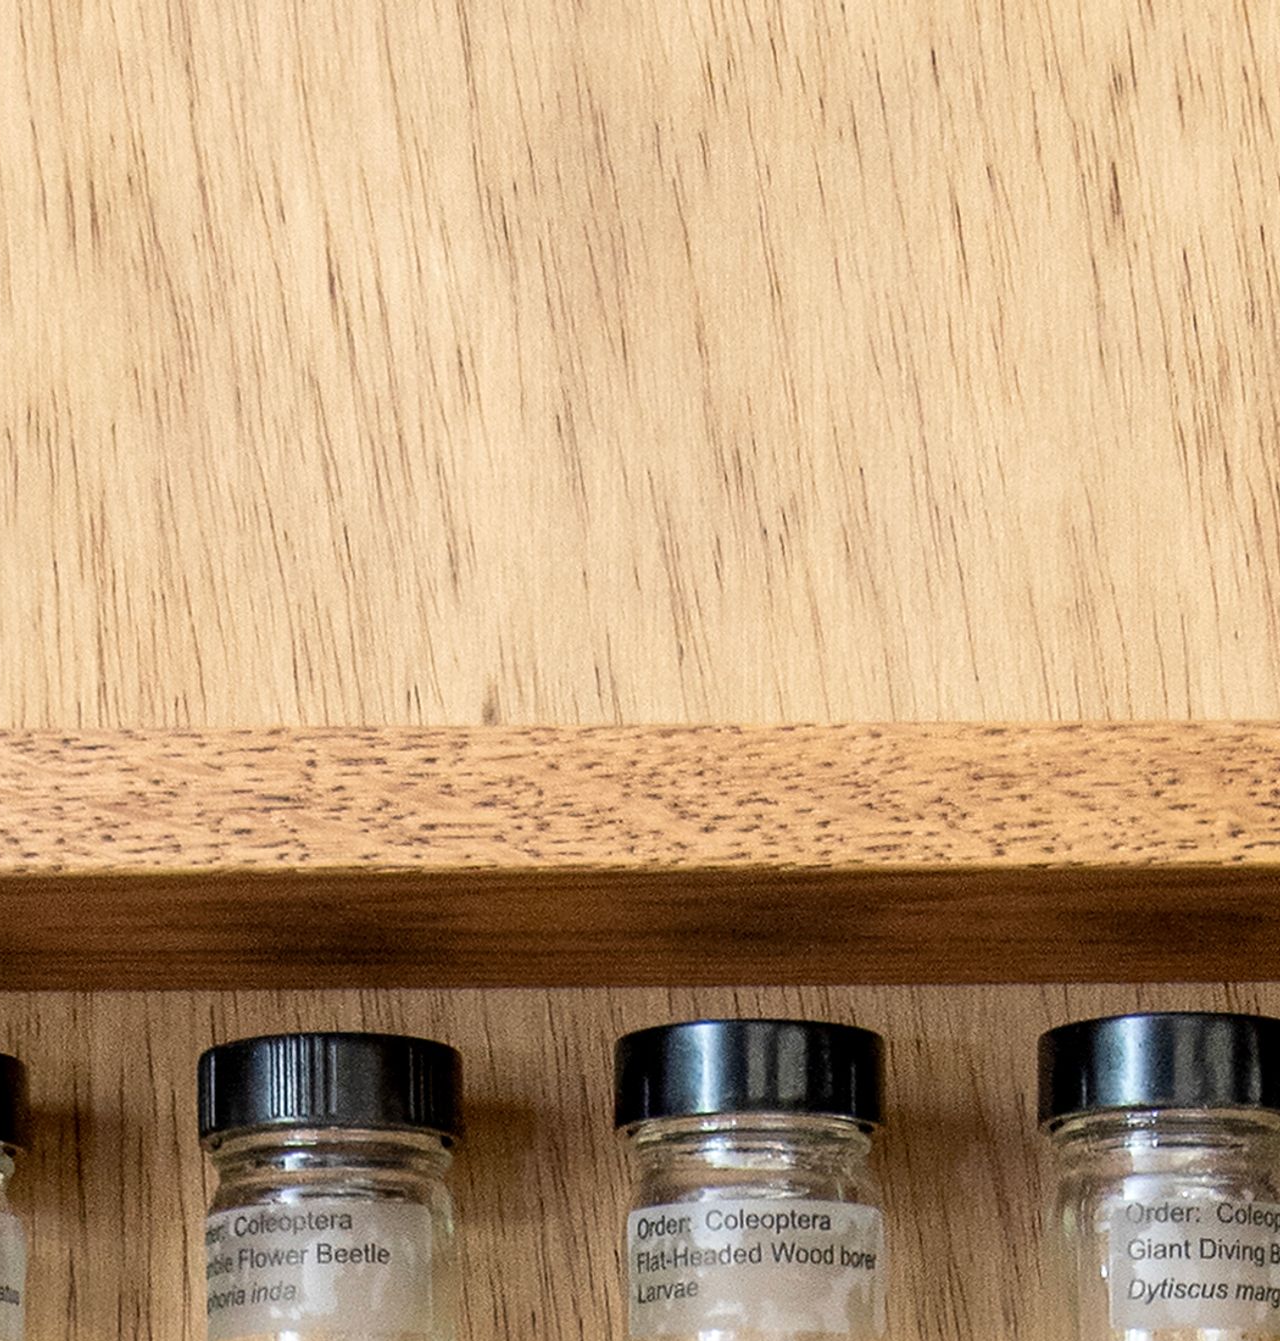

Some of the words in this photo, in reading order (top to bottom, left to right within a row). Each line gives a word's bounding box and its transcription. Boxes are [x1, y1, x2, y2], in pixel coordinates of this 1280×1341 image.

[234, 1211, 353, 1237] Coleoptera
[637, 1216, 692, 1240] Order:
[705, 1208, 832, 1235] Coleoptera
[1126, 1202, 1201, 1224] Order:
[238, 1247, 308, 1270] Flower
[316, 1242, 391, 1265] Beetle
[637, 1242, 763, 1274] Flat-Headed
[771, 1241, 835, 1265] Wood
[1127, 1238, 1192, 1261] Giant
[1200, 1237, 1266, 1267] Diving
[251, 1280, 297, 1304] inda
[637, 1279, 699, 1304] Larvae
[1127, 1277, 1229, 1304] Dytiscus
